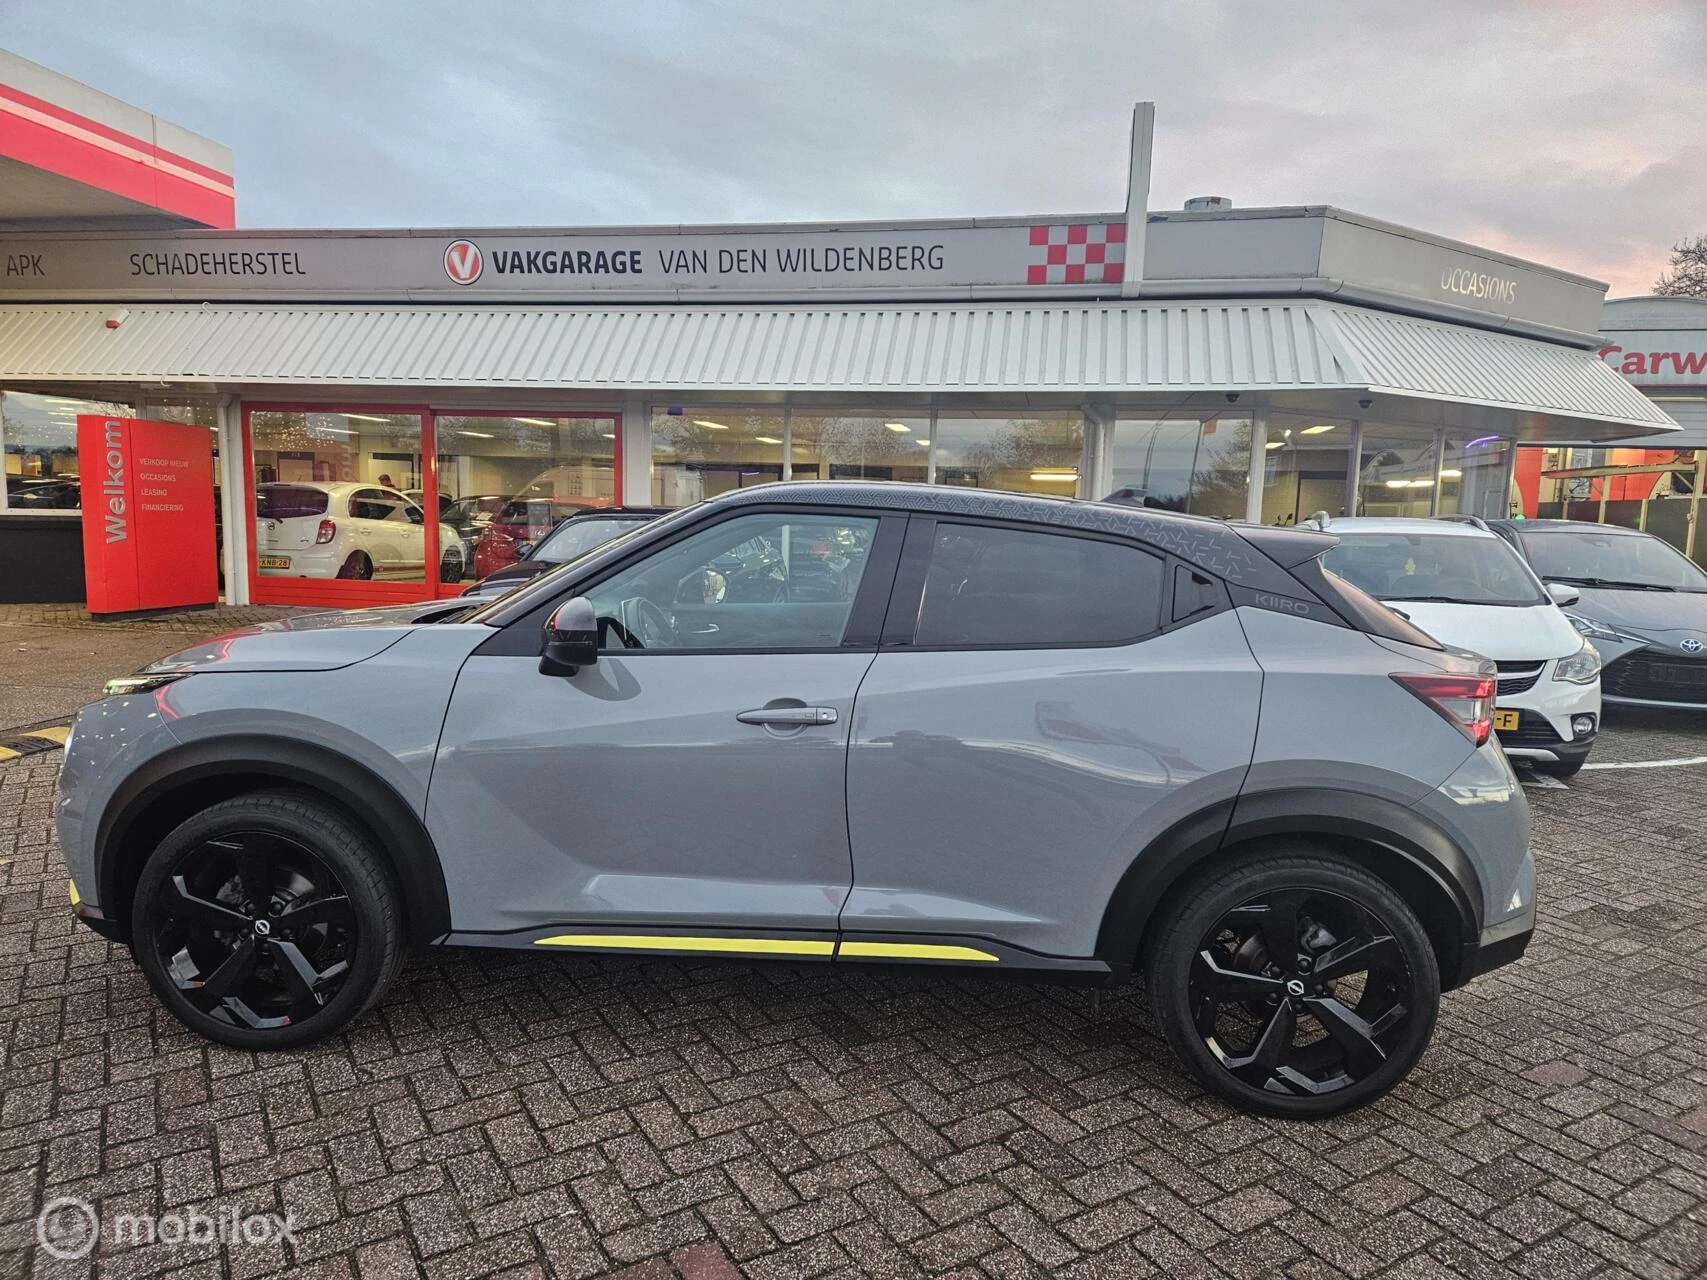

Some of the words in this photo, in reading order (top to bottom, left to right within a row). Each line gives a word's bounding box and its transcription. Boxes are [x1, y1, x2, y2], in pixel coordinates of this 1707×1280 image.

[6, 255, 46, 276] APK
[130, 252, 306, 276] SCHADEHERSTEL
[493, 250, 642, 274] VAKGARAGE
[659, 249, 708, 274] VAN
[719, 249, 768, 274] DEN
[777, 245, 944, 272] WILDENBERG
[1440, 266, 1518, 305] OCCASIONS
[139, 458, 169, 466] VERKOOP
[103, 420, 128, 544] Welkom
[140, 473, 177, 482] OCCASIONS
[141, 488, 168, 496] LEASING
[142, 504, 184, 512] FINANCIERING
[1255, 594, 1310, 615] KIIRO
